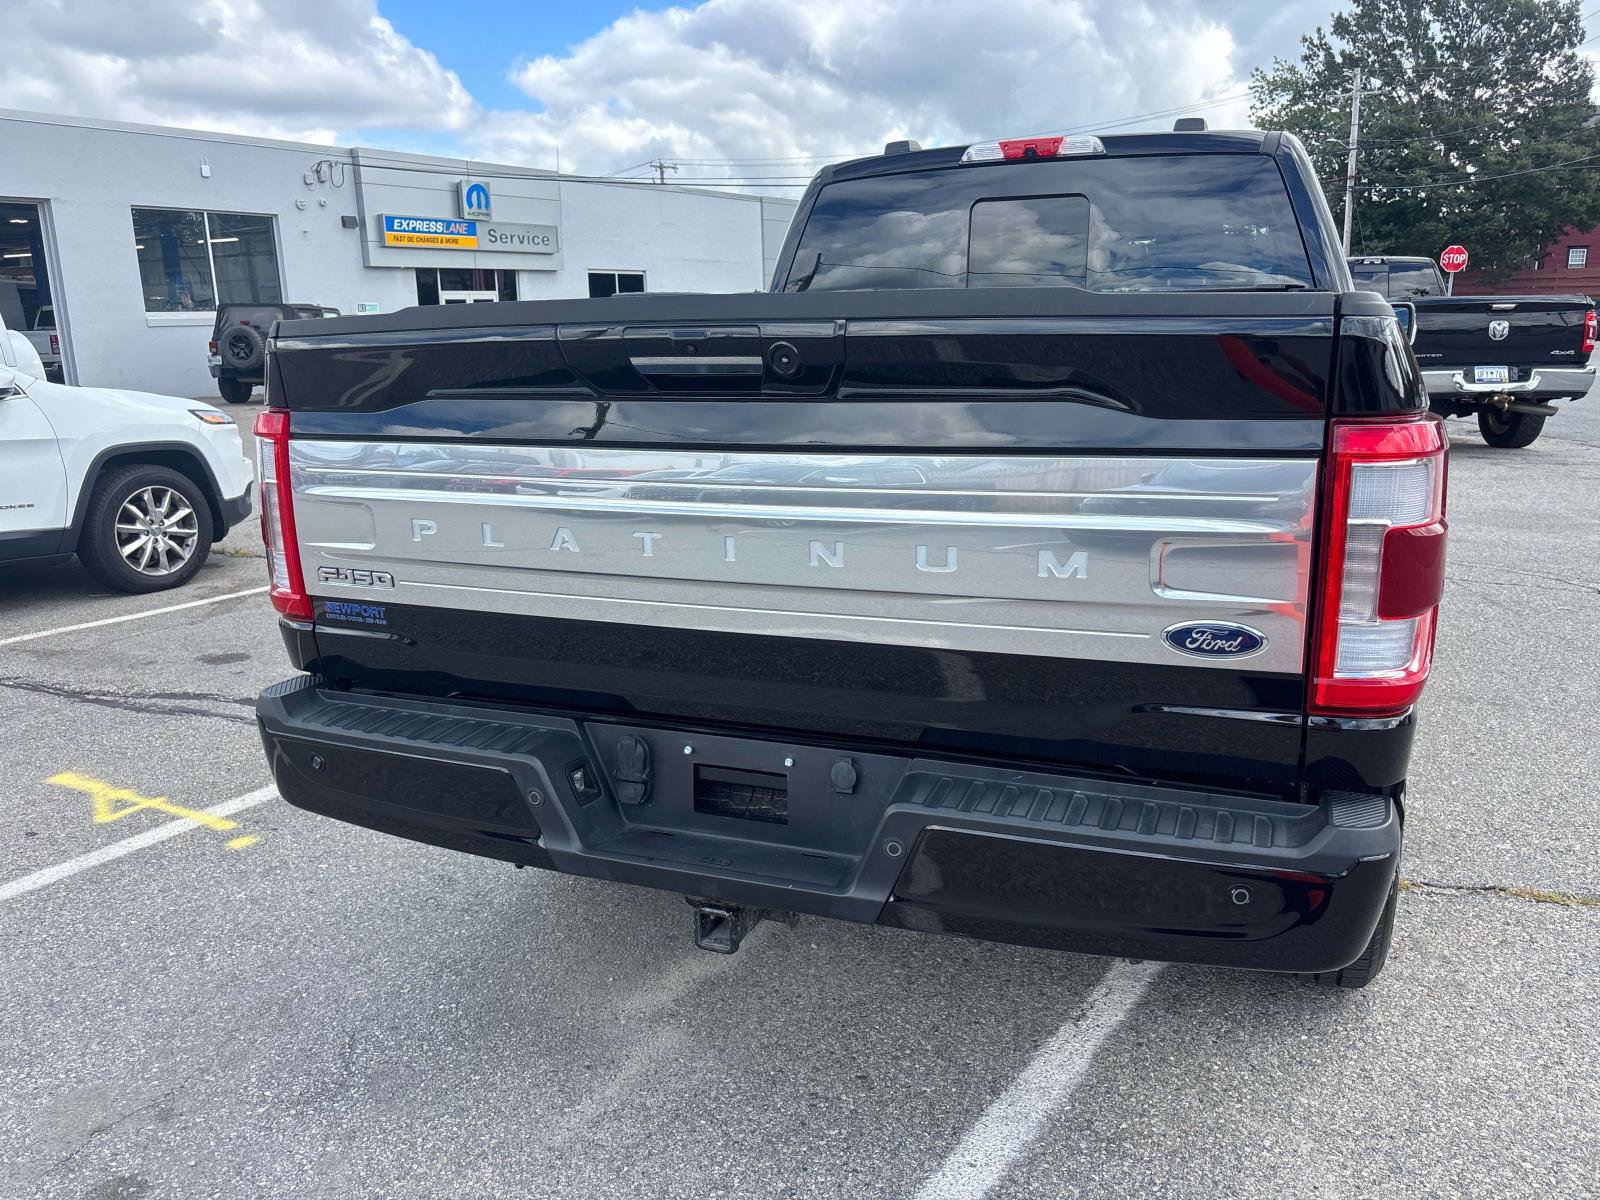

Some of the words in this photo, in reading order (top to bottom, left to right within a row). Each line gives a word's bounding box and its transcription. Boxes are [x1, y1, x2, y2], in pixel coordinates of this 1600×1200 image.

[393, 235, 406, 243] FAST
[487, 228, 551, 247] Service
[1442, 254, 1466, 264] STOP
[411, 518, 1089, 578] PLATINUM
[324, 601, 386, 618] NEWPORT
[1186, 628, 1243, 651] Ford
